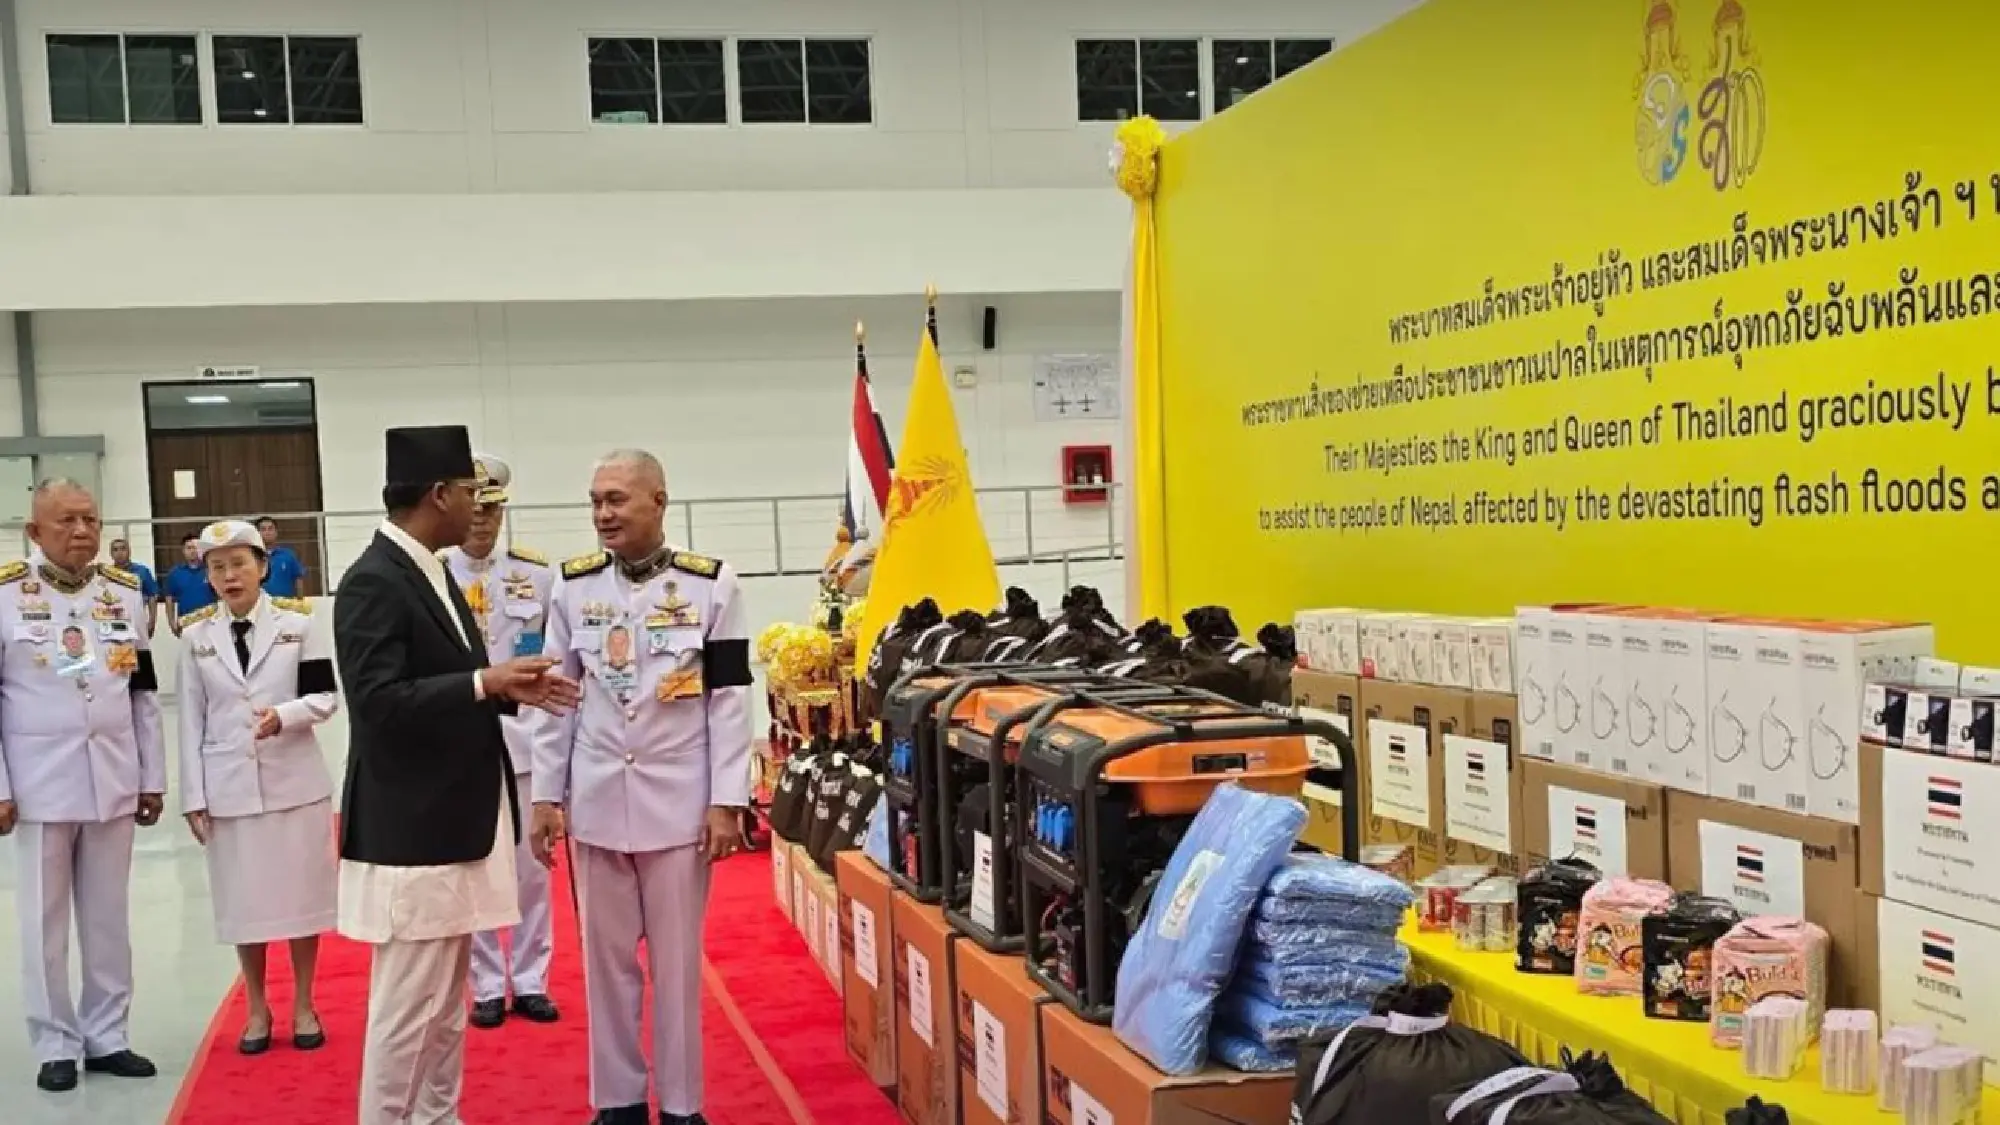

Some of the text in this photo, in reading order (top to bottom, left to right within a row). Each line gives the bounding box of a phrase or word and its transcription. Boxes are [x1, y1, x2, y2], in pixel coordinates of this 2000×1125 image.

[1388, 248, 1634, 344] พระบาทสมเด็จพระเจ้าอยู่หัว
[1641, 171, 1942, 290] และสมเด็จพระนางเจ้า
[1955, 179, 1975, 221] ฯ
[1324, 443, 1360, 472] Their
[1363, 436, 1438, 476] Majesties
[1443, 431, 1470, 463] the
[1475, 426, 1517, 466] King
[1523, 419, 1558, 456] and
[1564, 415, 1633, 453] Queen
[1640, 405, 1663, 445] of
[1672, 390, 1788, 442] Thailand
[1798, 371, 1971, 443] graciously
[1259, 508, 1272, 530] to
[1274, 502, 1311, 530] assist
[1314, 501, 1336, 529] the
[1339, 498, 1387, 535] people
[1391, 495, 1406, 526] of
[1410, 494, 1459, 533] Nepal
[1463, 489, 1539, 525] affected
[1545, 487, 1569, 531] by
[1575, 486, 1612, 521] the
[1618, 477, 1763, 528] devastating
[1774, 470, 1849, 517] flash
[1860, 465, 1967, 513] floods
